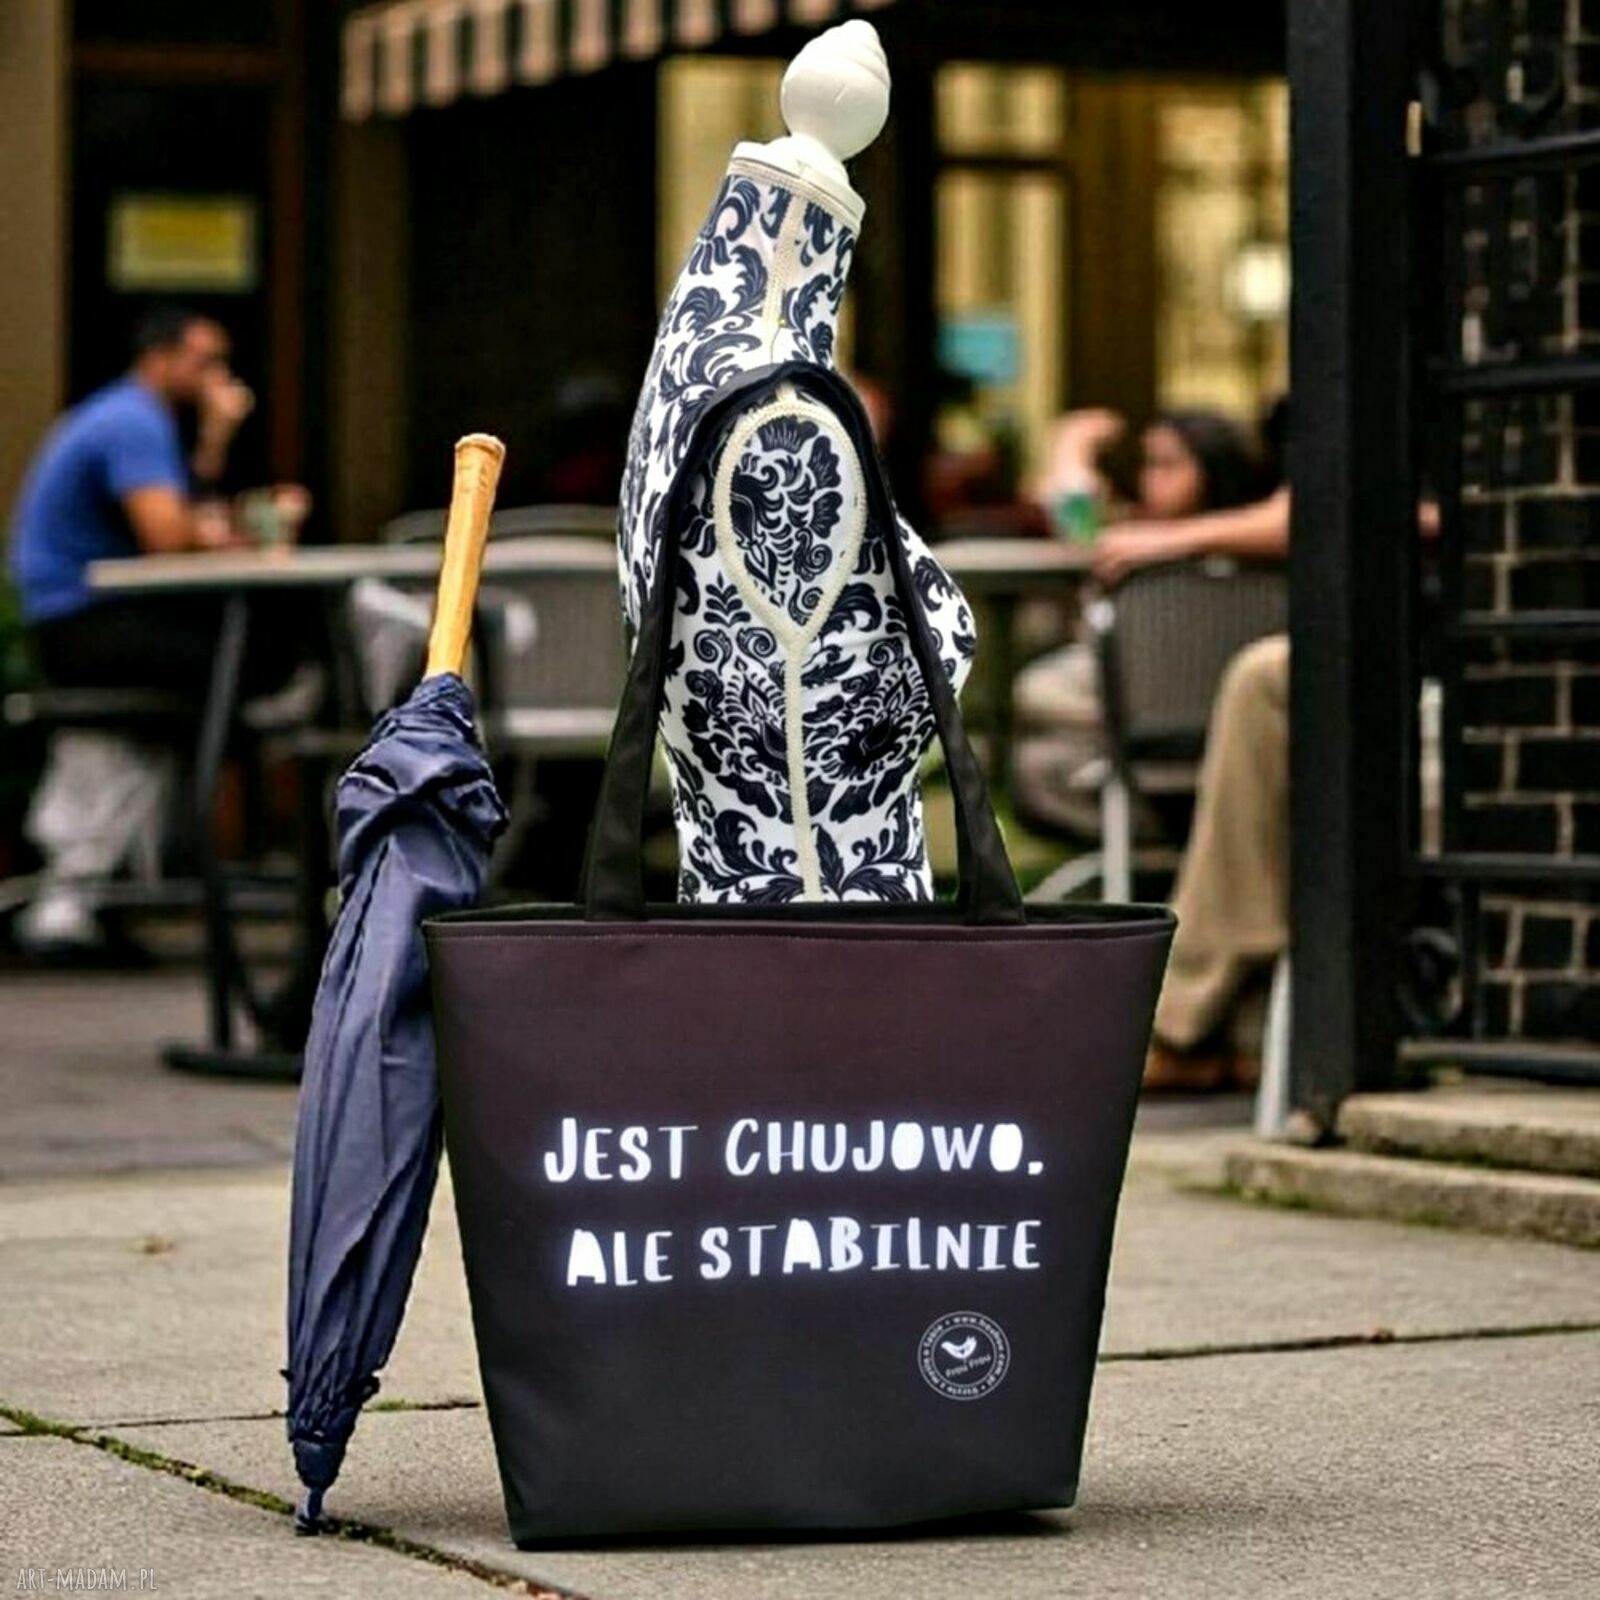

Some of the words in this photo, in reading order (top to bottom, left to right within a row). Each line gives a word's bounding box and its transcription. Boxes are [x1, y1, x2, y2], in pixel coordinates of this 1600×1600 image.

[543, 1117, 699, 1182] JEST
[724, 1117, 1044, 1177] CHUJOWO.
[566, 1228, 674, 1287] ALE
[699, 1216, 1042, 1280] STABILNIE
